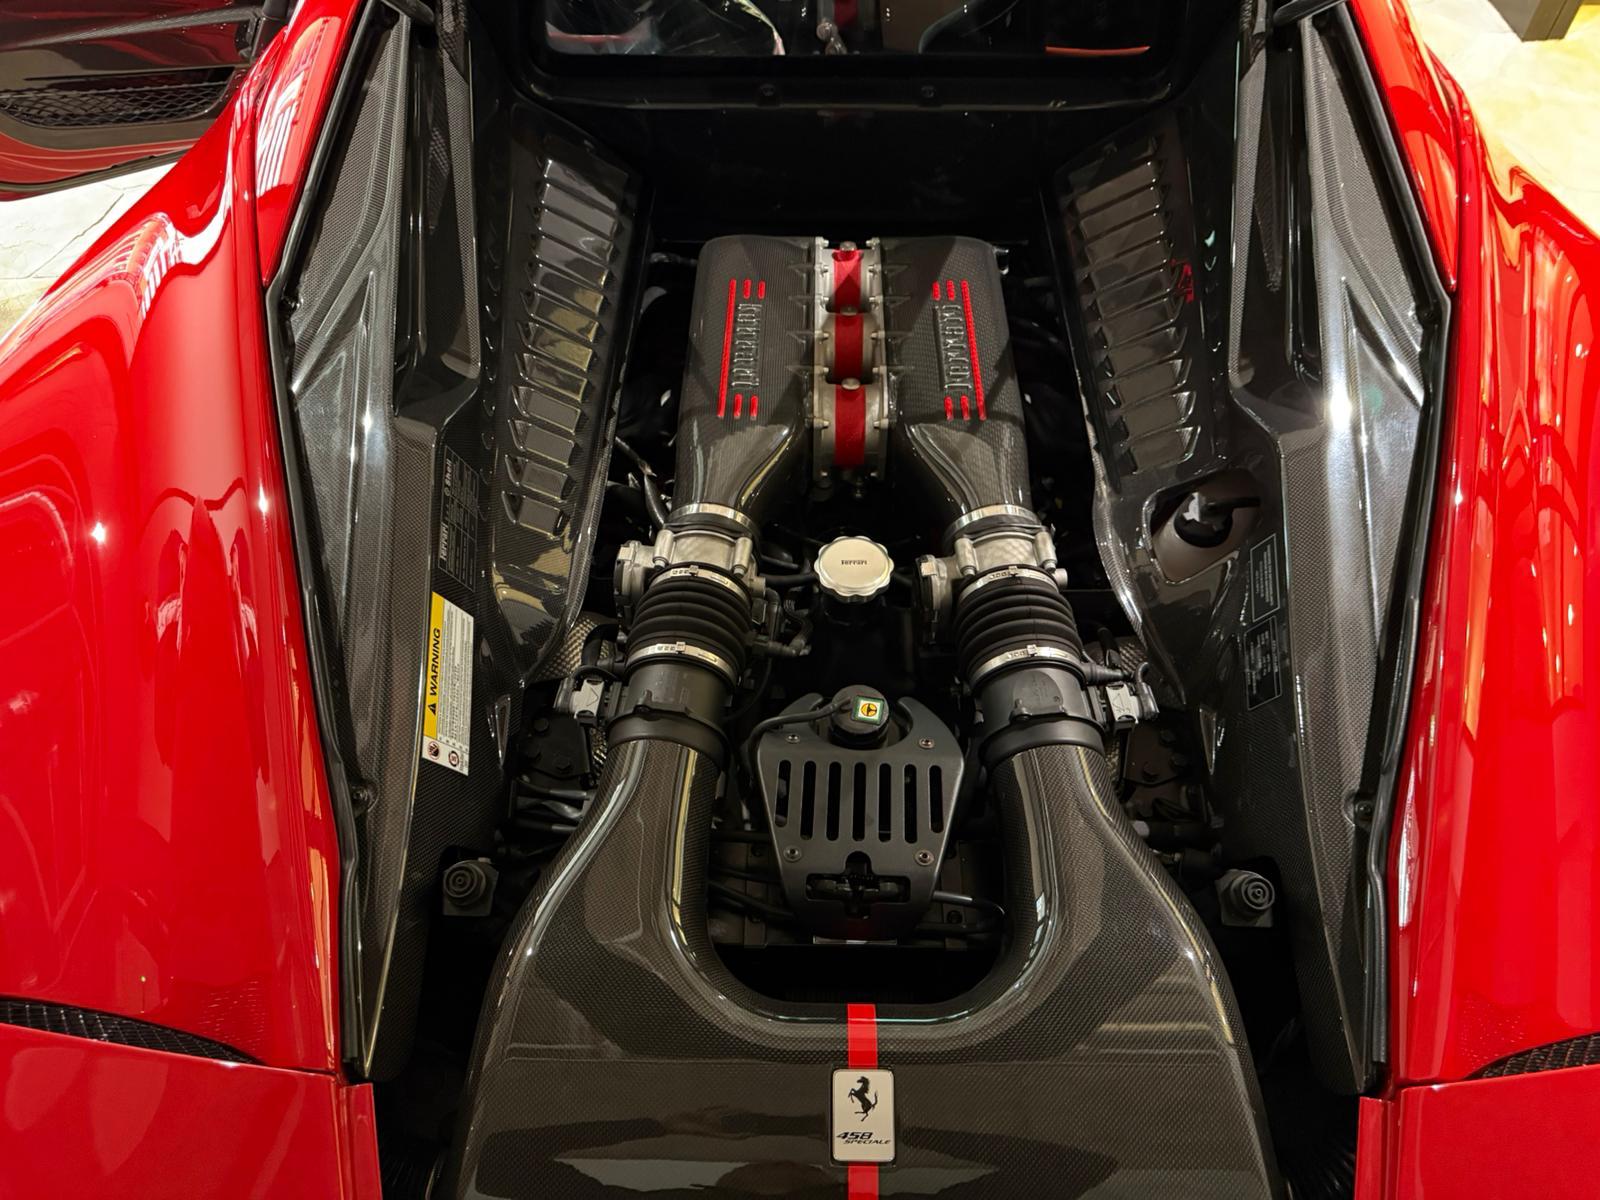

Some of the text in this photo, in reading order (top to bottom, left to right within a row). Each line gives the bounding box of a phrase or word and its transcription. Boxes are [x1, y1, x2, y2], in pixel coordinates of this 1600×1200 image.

[444, 458, 452, 487] Shell
[439, 521, 449, 561] Ferrari
[429, 628, 442, 697] WARNING
[835, 1131, 874, 1140] 458
